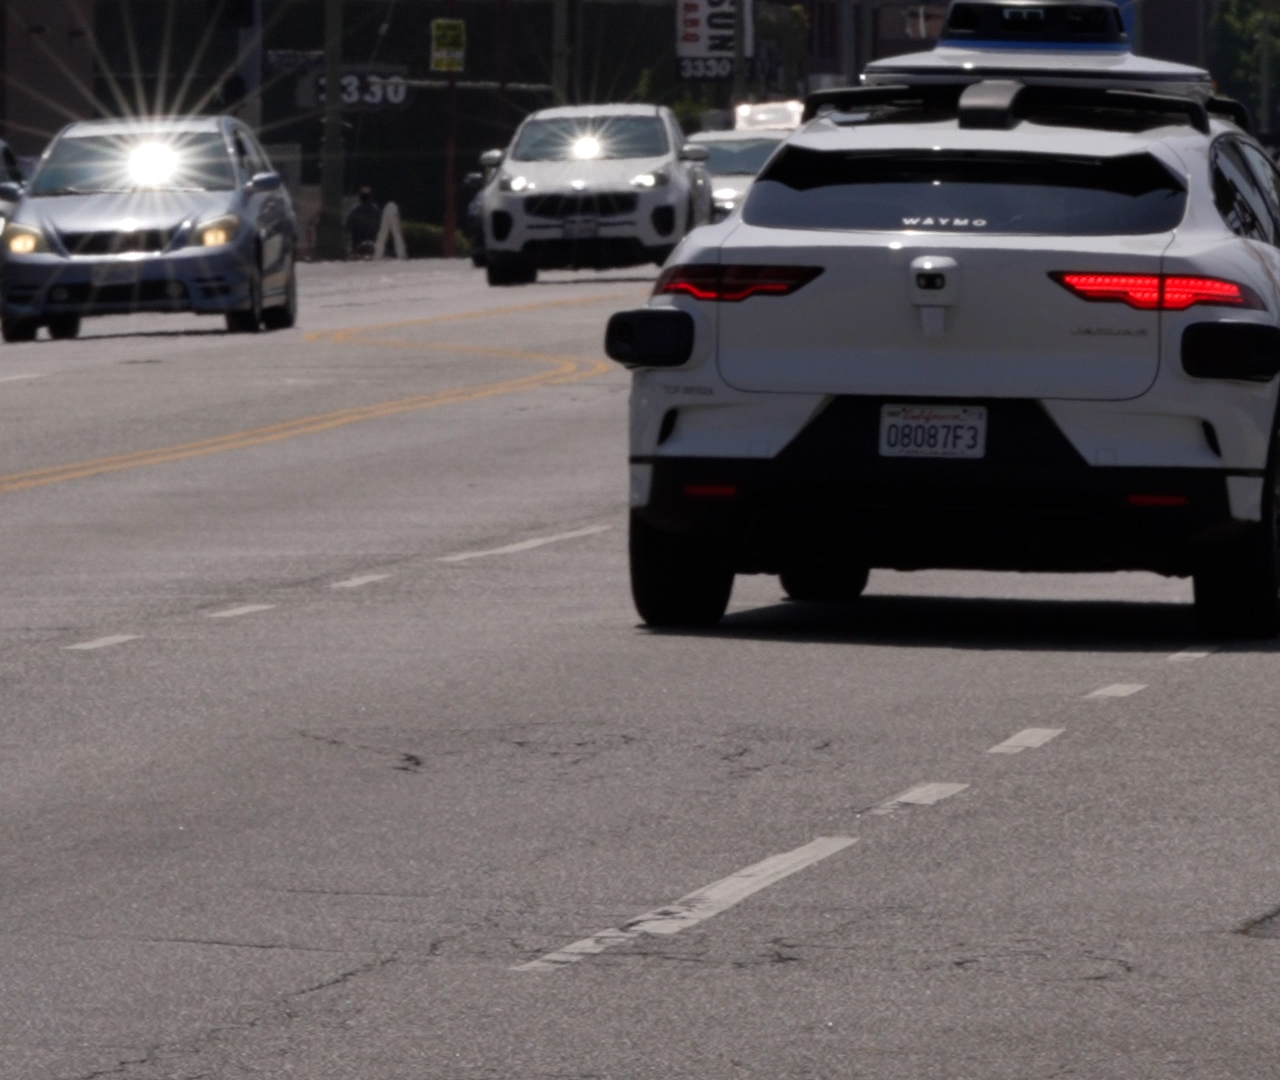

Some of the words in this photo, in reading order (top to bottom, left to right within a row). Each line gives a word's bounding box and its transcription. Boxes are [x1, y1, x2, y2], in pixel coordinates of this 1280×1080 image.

[681, 59, 731, 78] 3330
[902, 217, 987, 227] WAYMO
[887, 424, 978, 449] 08087F3
